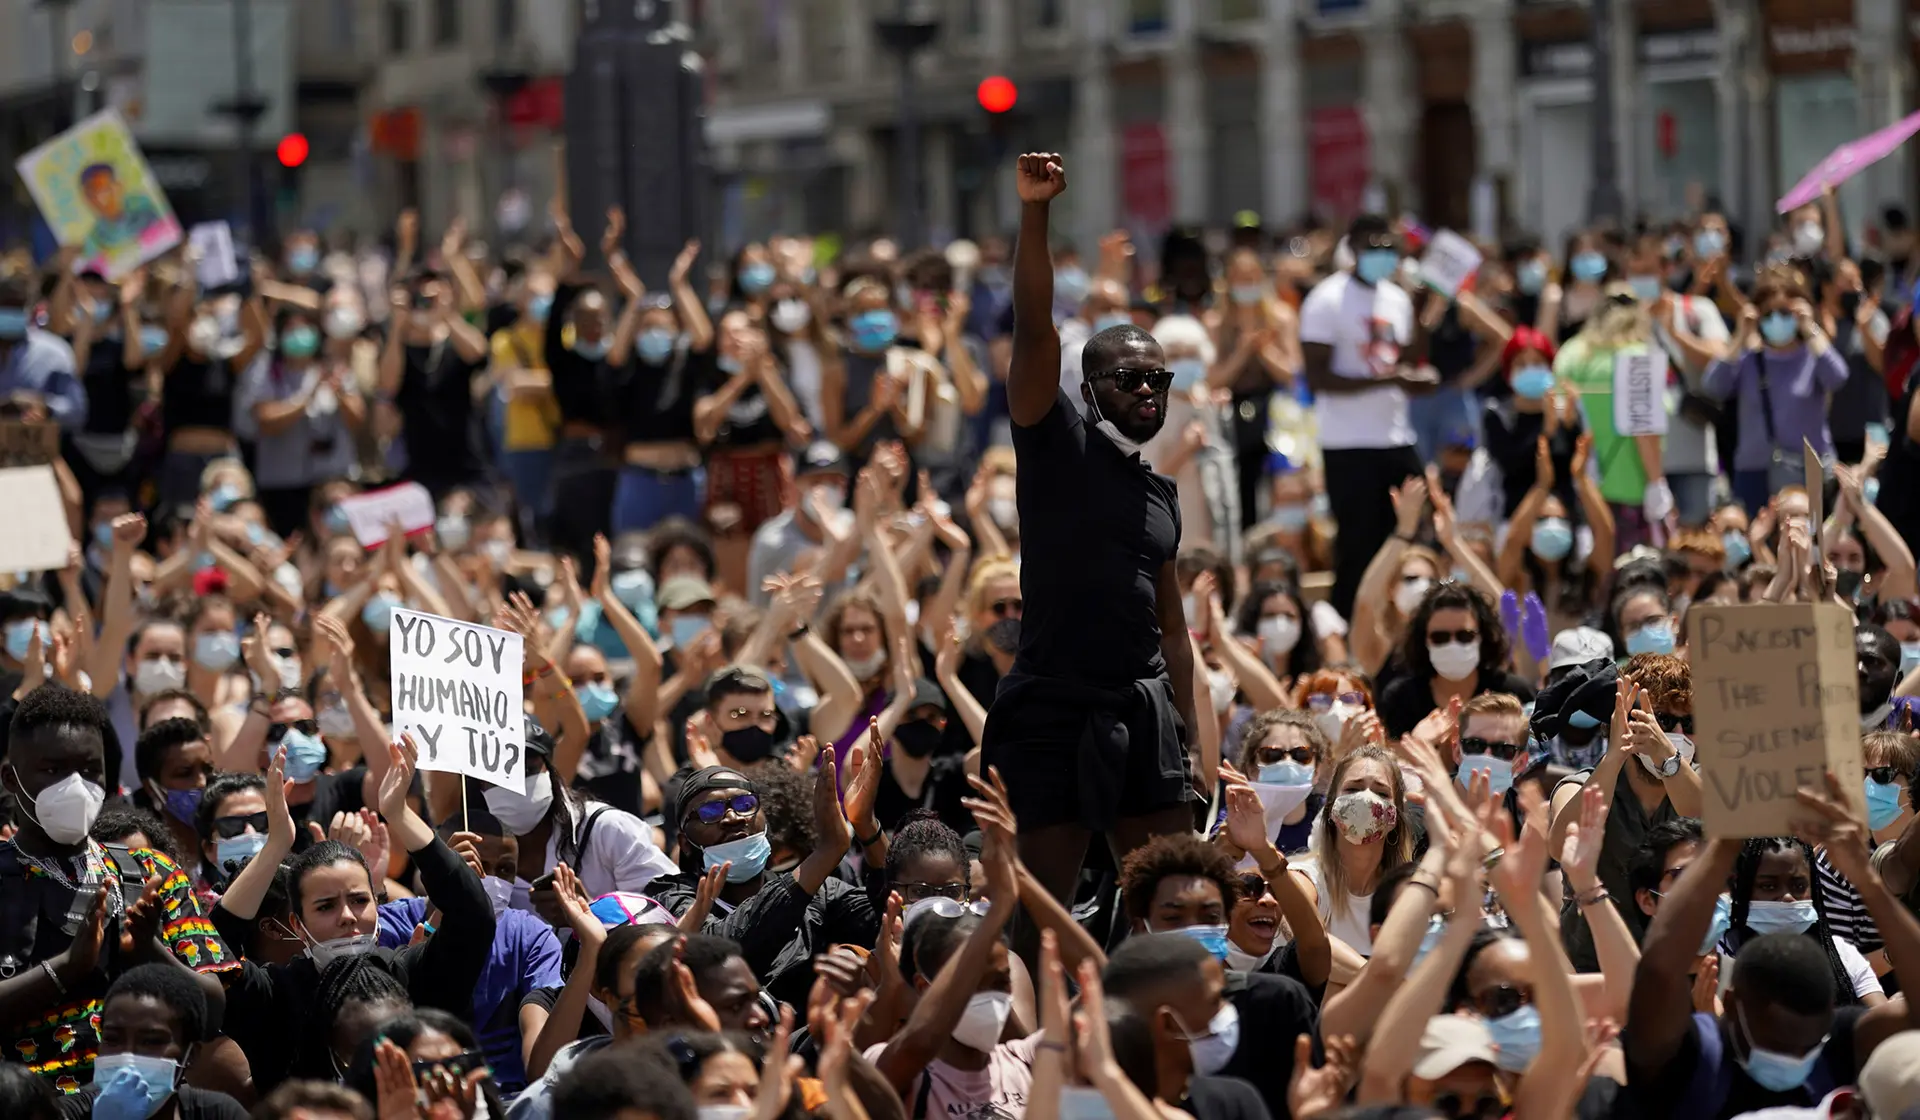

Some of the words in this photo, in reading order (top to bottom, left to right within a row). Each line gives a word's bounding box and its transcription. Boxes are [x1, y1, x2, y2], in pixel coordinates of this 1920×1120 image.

[395, 613, 436, 658] YO
[443, 627, 506, 674] SOY
[398, 672, 515, 732] HUMANO.
[1704, 675, 1768, 712] THE
